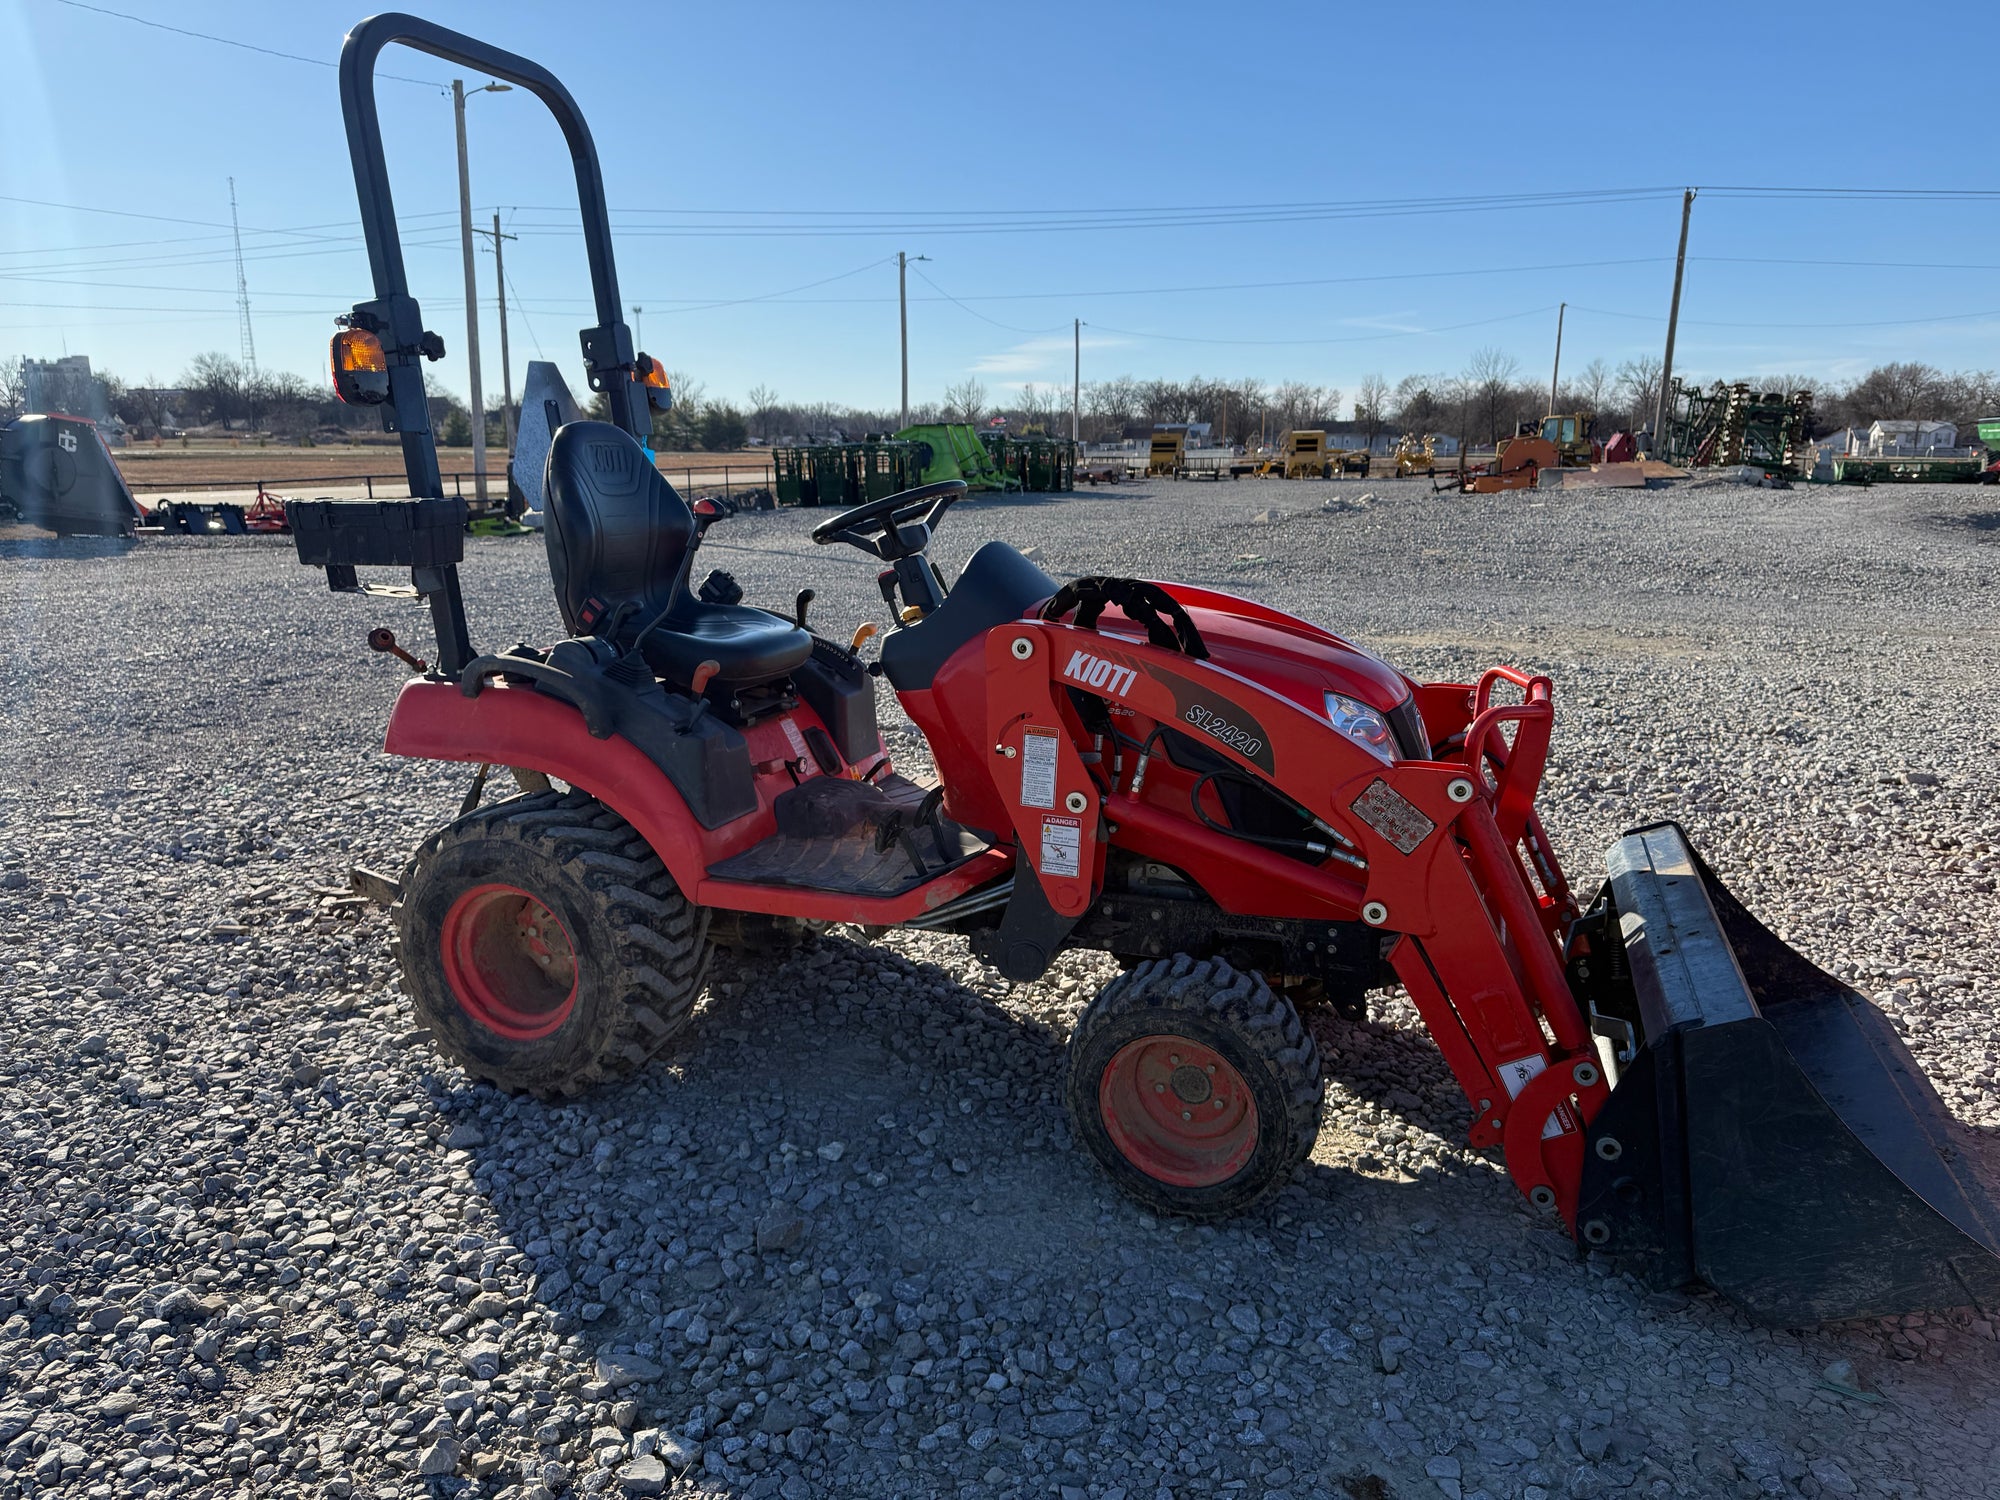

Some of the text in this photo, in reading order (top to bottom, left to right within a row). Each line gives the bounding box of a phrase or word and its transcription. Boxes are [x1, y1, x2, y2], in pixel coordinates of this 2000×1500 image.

[588, 443, 628, 473] KIOTI
[1064, 650, 1138, 697] KIOTI
[1185, 704, 1262, 757] SL2420
[1051, 818, 1077, 826] DANGER
[1556, 1104, 1572, 1130] ANGER
